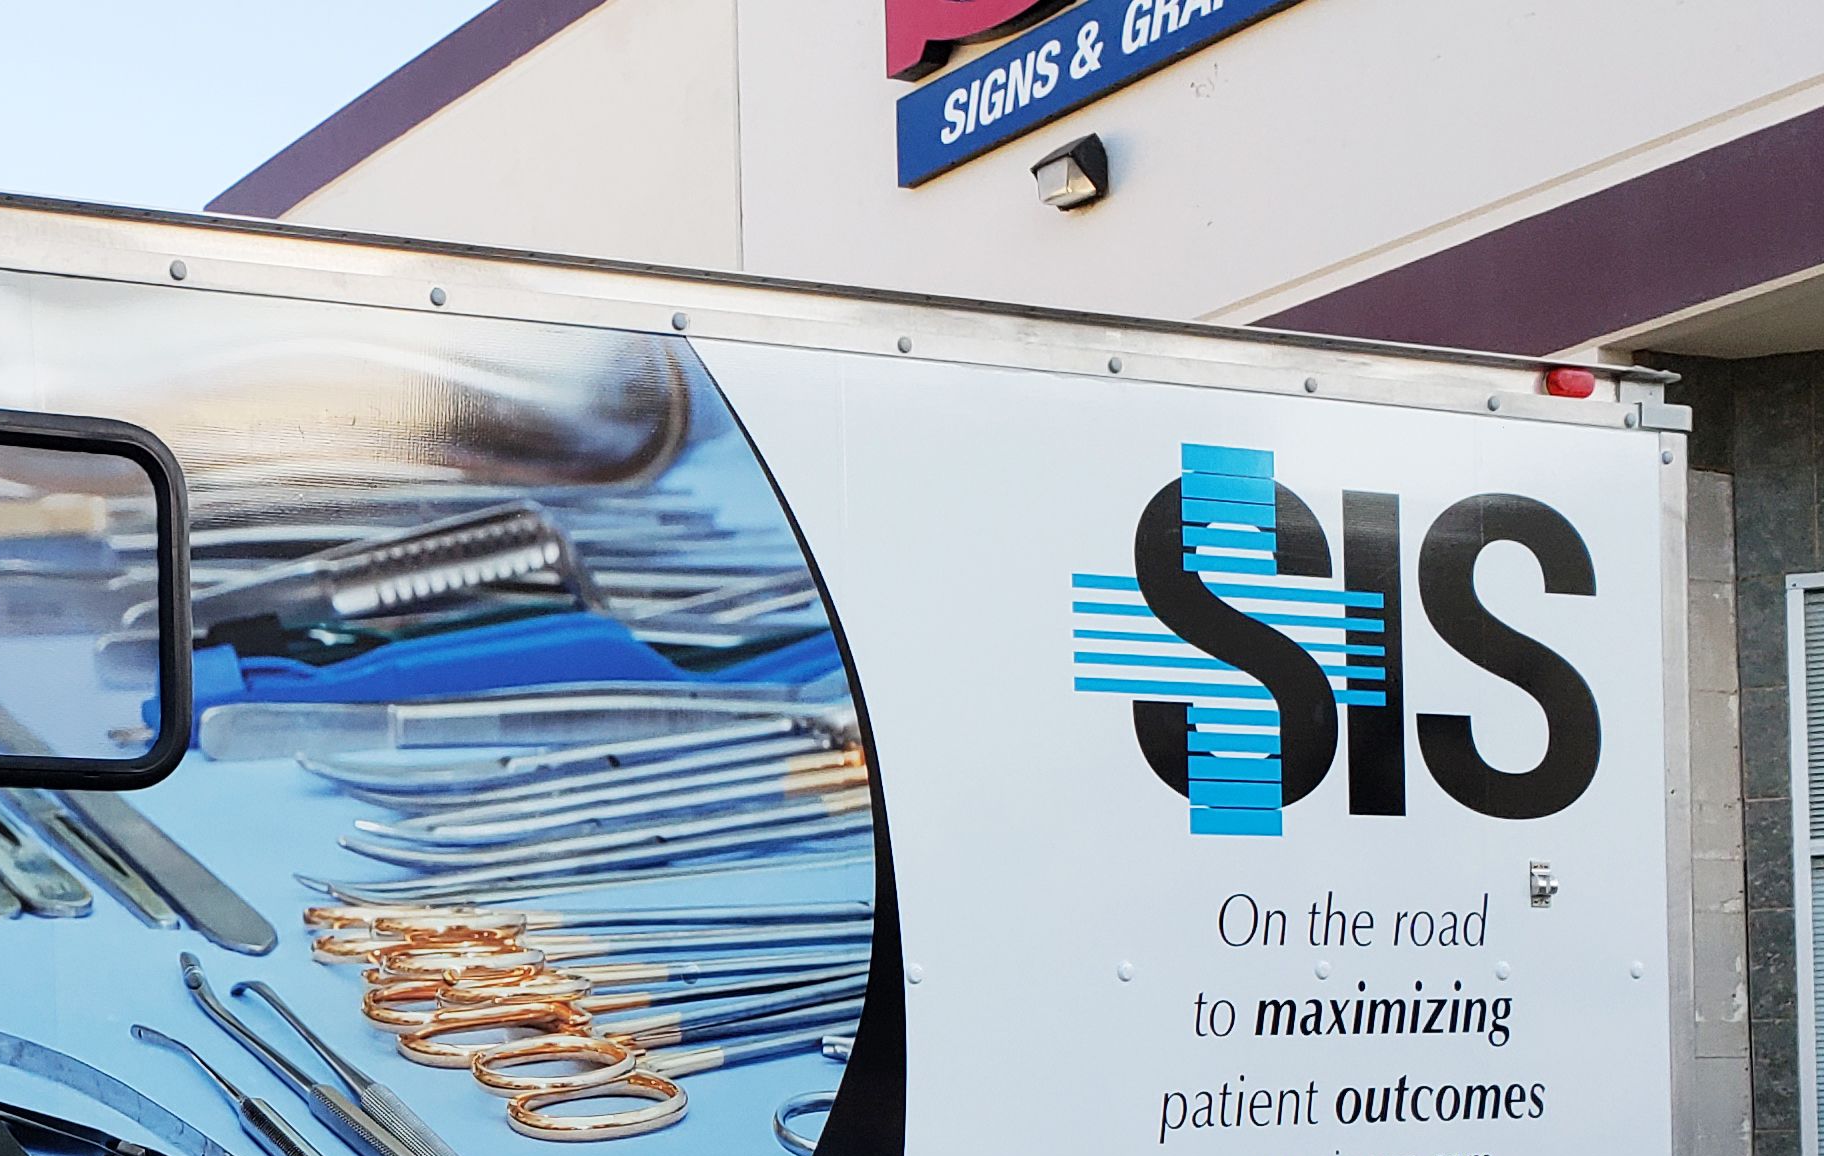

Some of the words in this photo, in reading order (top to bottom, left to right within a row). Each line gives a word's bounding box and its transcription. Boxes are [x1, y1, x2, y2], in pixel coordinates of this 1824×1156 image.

[940, 39, 1061, 145] SIGNS
[1069, 20, 1104, 80] &
[1121, 0, 1224, 55] GRA
[1132, 470, 1602, 820] SIS
[1218, 893, 1287, 947] On
[1307, 890, 1375, 947] the
[1393, 892, 1488, 947] road
[1193, 991, 1236, 1038] to
[1254, 980, 1513, 1048] maximizing
[1159, 1074, 1319, 1144] patient
[1335, 1074, 1546, 1125] outcomes
